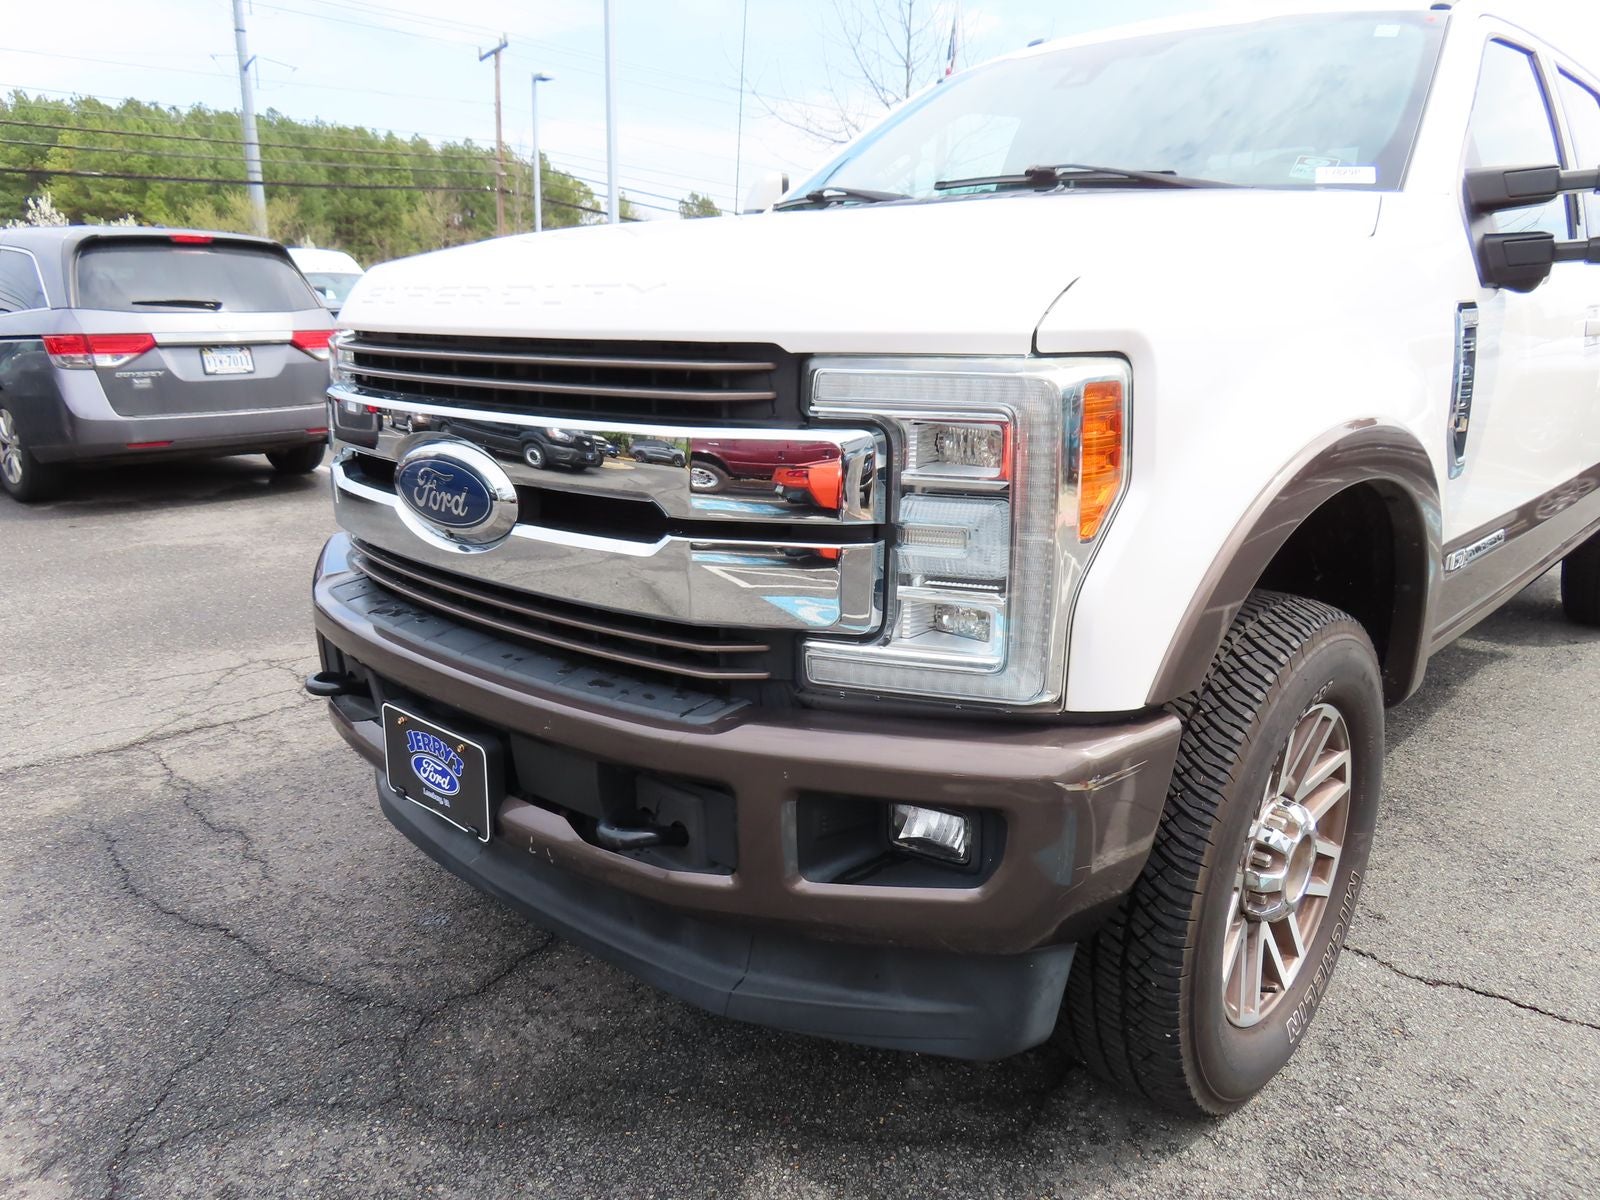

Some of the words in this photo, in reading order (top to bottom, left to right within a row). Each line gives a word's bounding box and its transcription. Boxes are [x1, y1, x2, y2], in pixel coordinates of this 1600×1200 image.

[413, 467, 469, 517] Ford
[406, 729, 464, 777] JERRY'S
[420, 758, 451, 790] Ford
[1285, 870, 1362, 1044] MICHELIN
